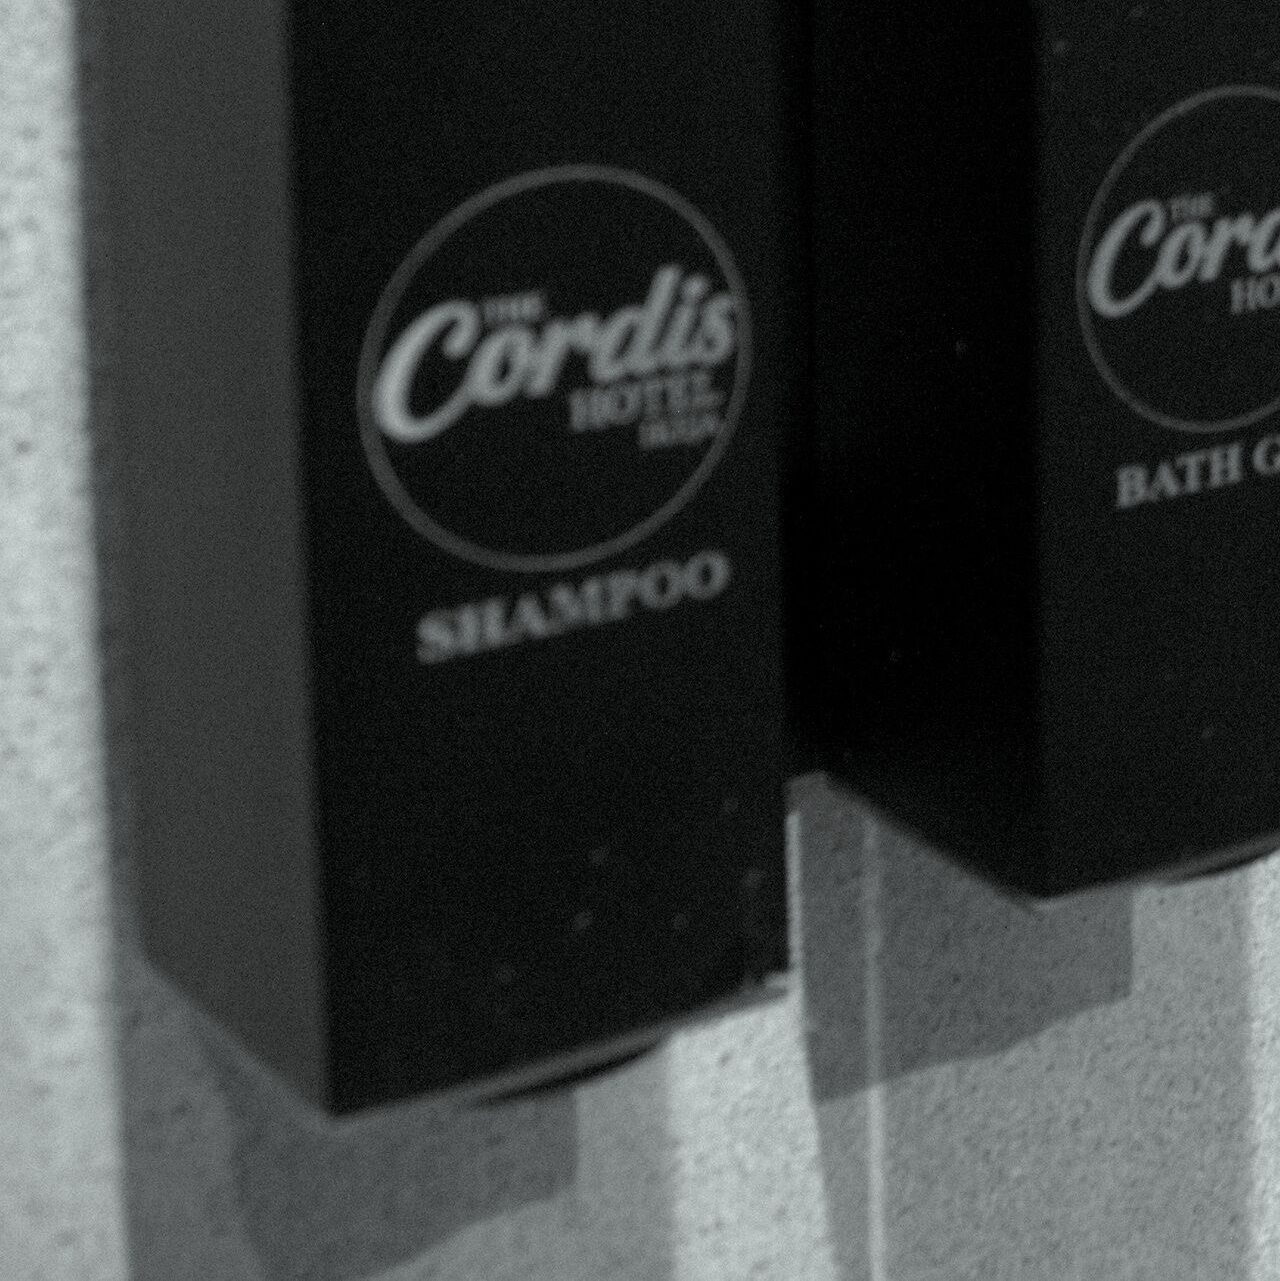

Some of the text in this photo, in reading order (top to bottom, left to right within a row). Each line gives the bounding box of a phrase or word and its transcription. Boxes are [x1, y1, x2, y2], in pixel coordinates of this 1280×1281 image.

[373, 263, 737, 442] Cordis
[1116, 442, 1243, 508] BATH
[417, 550, 730, 664] SHAMPOO
